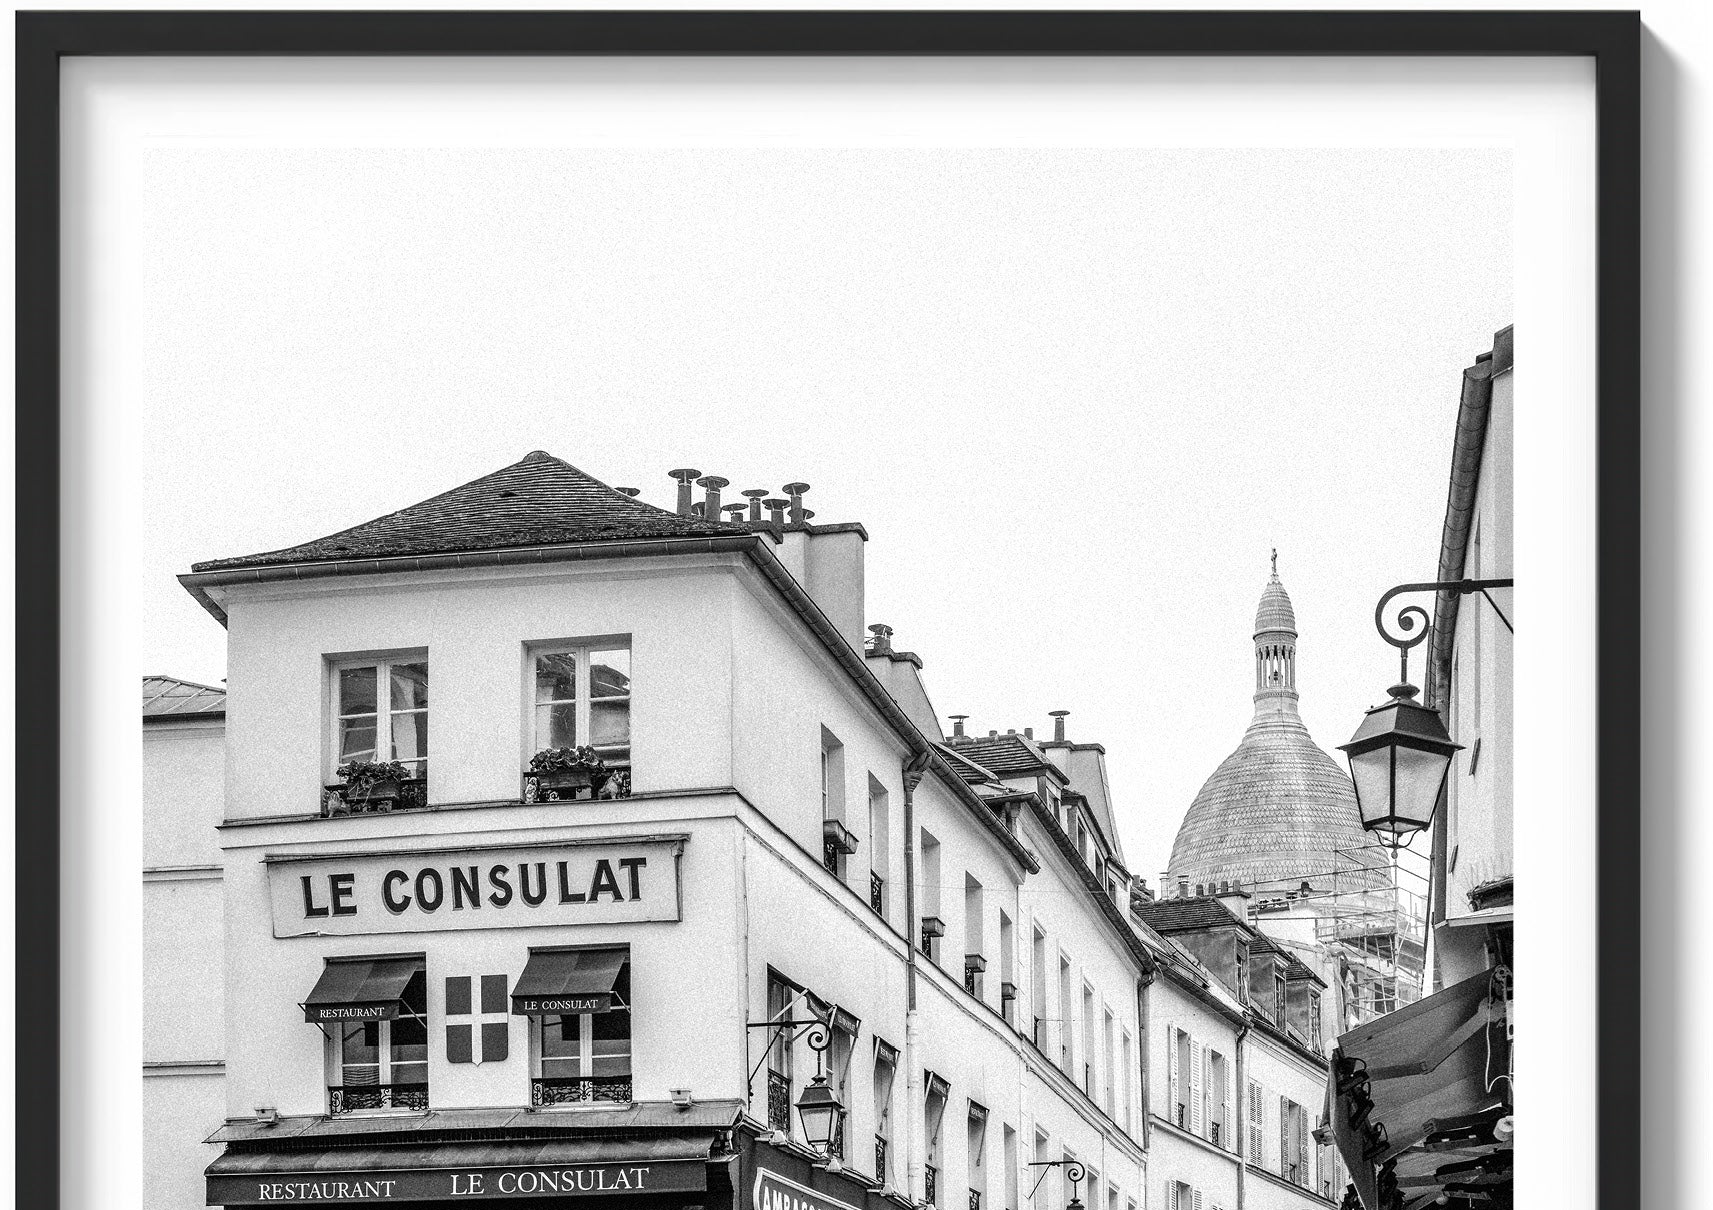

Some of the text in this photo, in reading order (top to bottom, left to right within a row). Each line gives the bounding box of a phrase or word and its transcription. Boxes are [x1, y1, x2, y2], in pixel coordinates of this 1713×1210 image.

[301, 857, 647, 919] LE CONSULAT
[320, 1007, 385, 1018] RESTAURANT
[524, 999, 599, 1010] LE CONSULAT
[259, 1180, 396, 1200] RESTAURANT
[450, 1167, 650, 1195] LE CONSULAT
